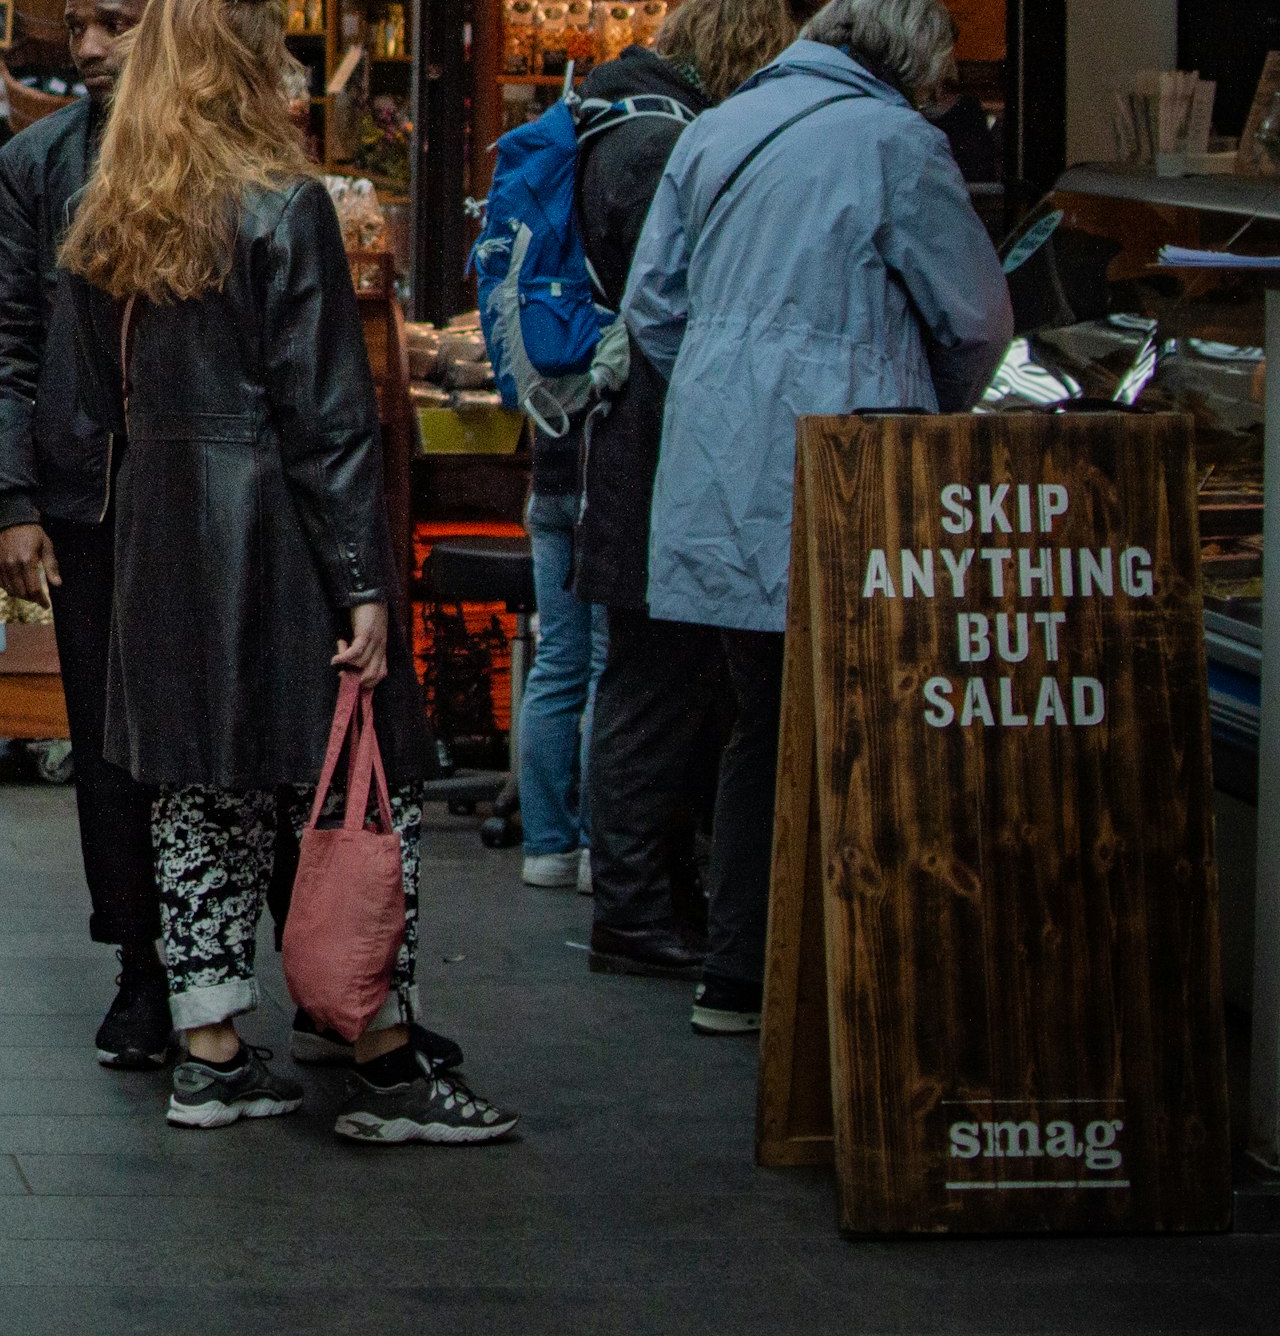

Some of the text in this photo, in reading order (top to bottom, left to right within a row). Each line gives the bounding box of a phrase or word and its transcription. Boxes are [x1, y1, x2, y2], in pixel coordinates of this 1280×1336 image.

[941, 483, 1070, 533] SKIP
[863, 547, 1155, 598] ANYTHING
[957, 612, 1067, 663] BUT
[923, 676, 1106, 728] SALAD
[949, 1111, 1125, 1172] smag
